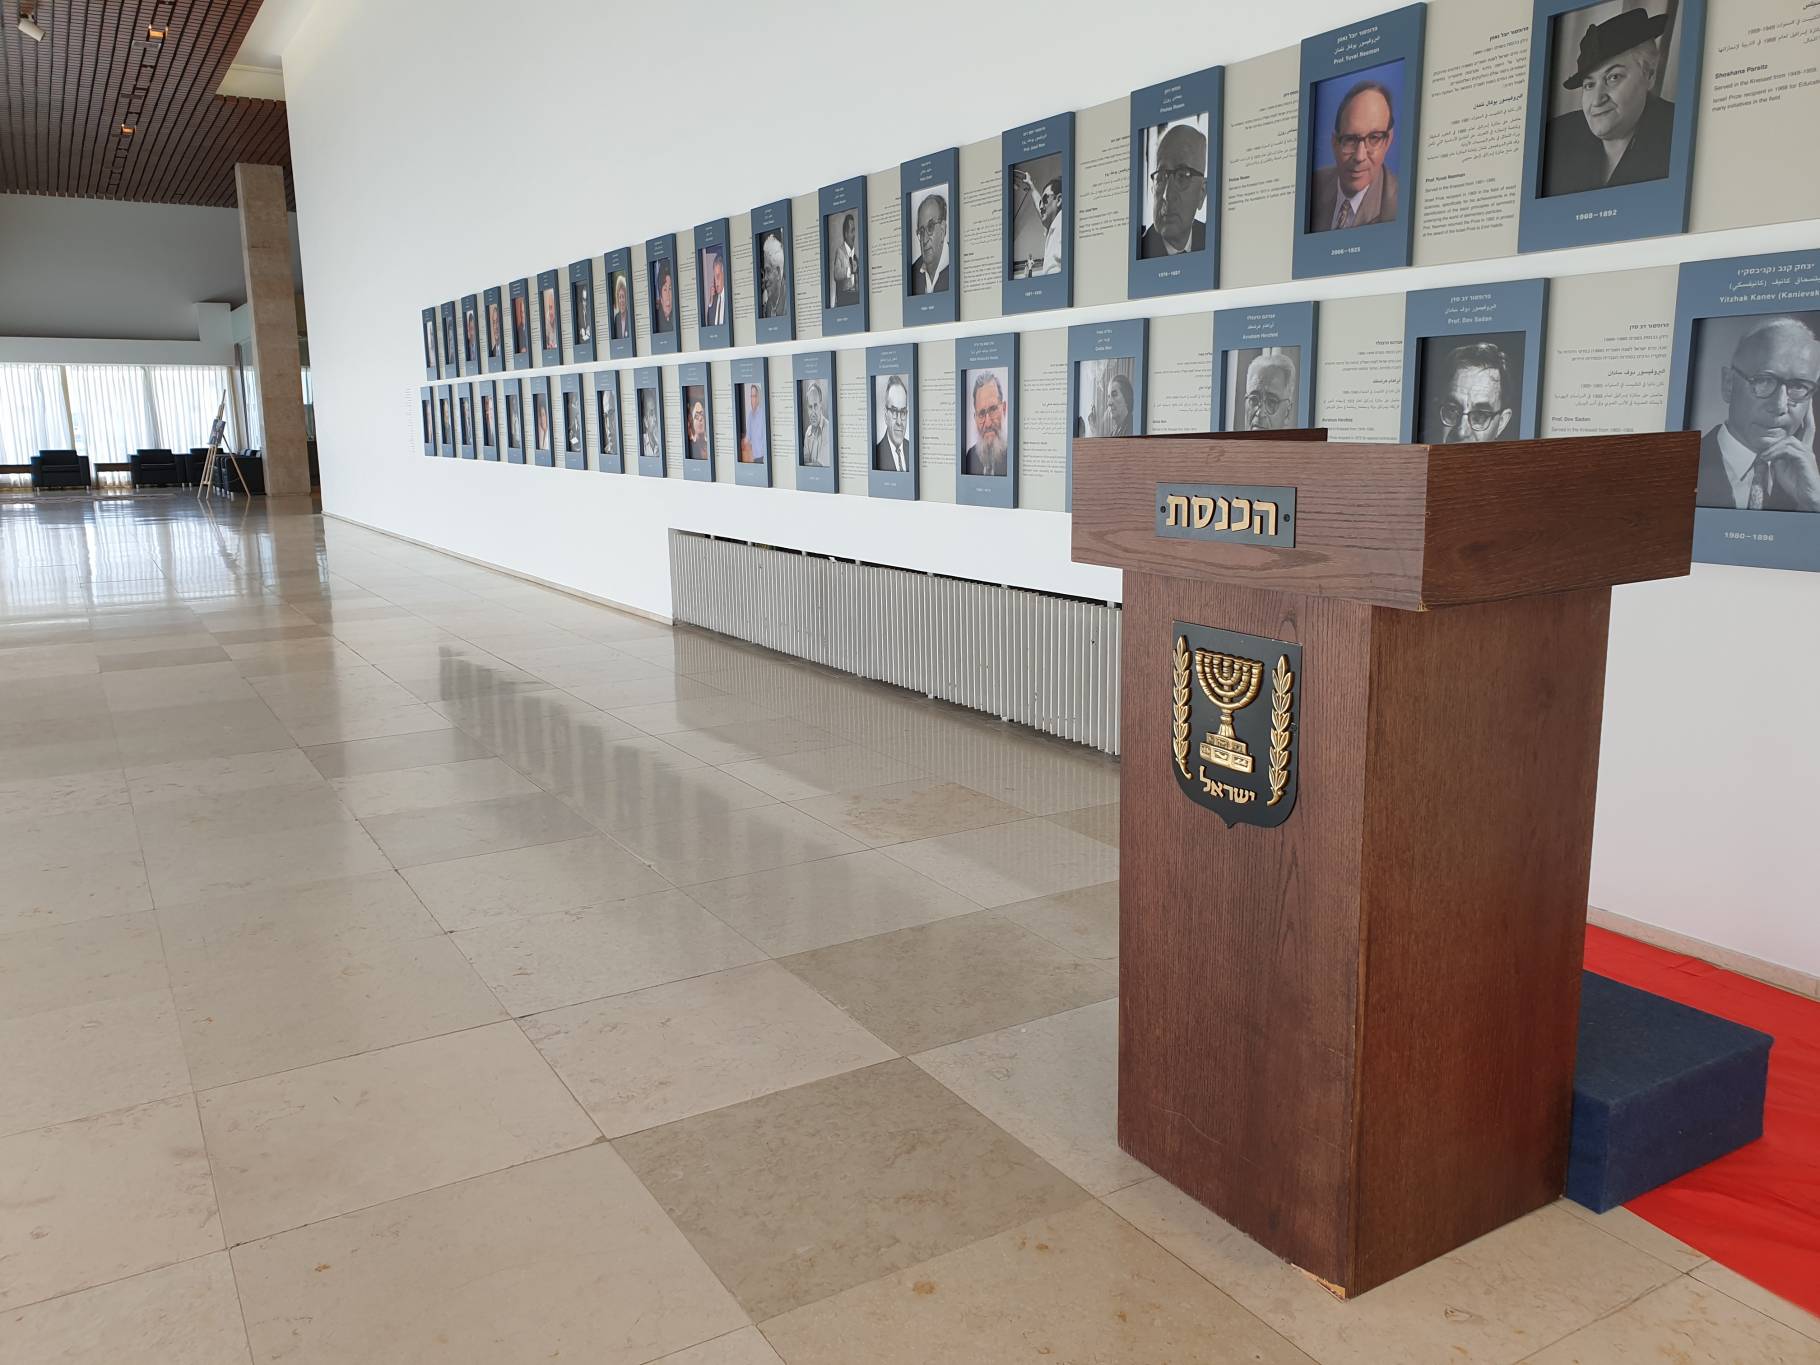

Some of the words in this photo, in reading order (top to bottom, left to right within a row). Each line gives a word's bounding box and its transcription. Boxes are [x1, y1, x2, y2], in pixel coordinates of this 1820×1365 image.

[1778, 265, 1793, 273] קנב
[1794, 263, 1815, 272] יצחק
[1750, 292, 1776, 301] Kanev
[1778, 288, 1820, 301] (Kanievsk
[1166, 494, 1279, 536] הכנסת
[1199, 765, 1257, 804] ישראל
